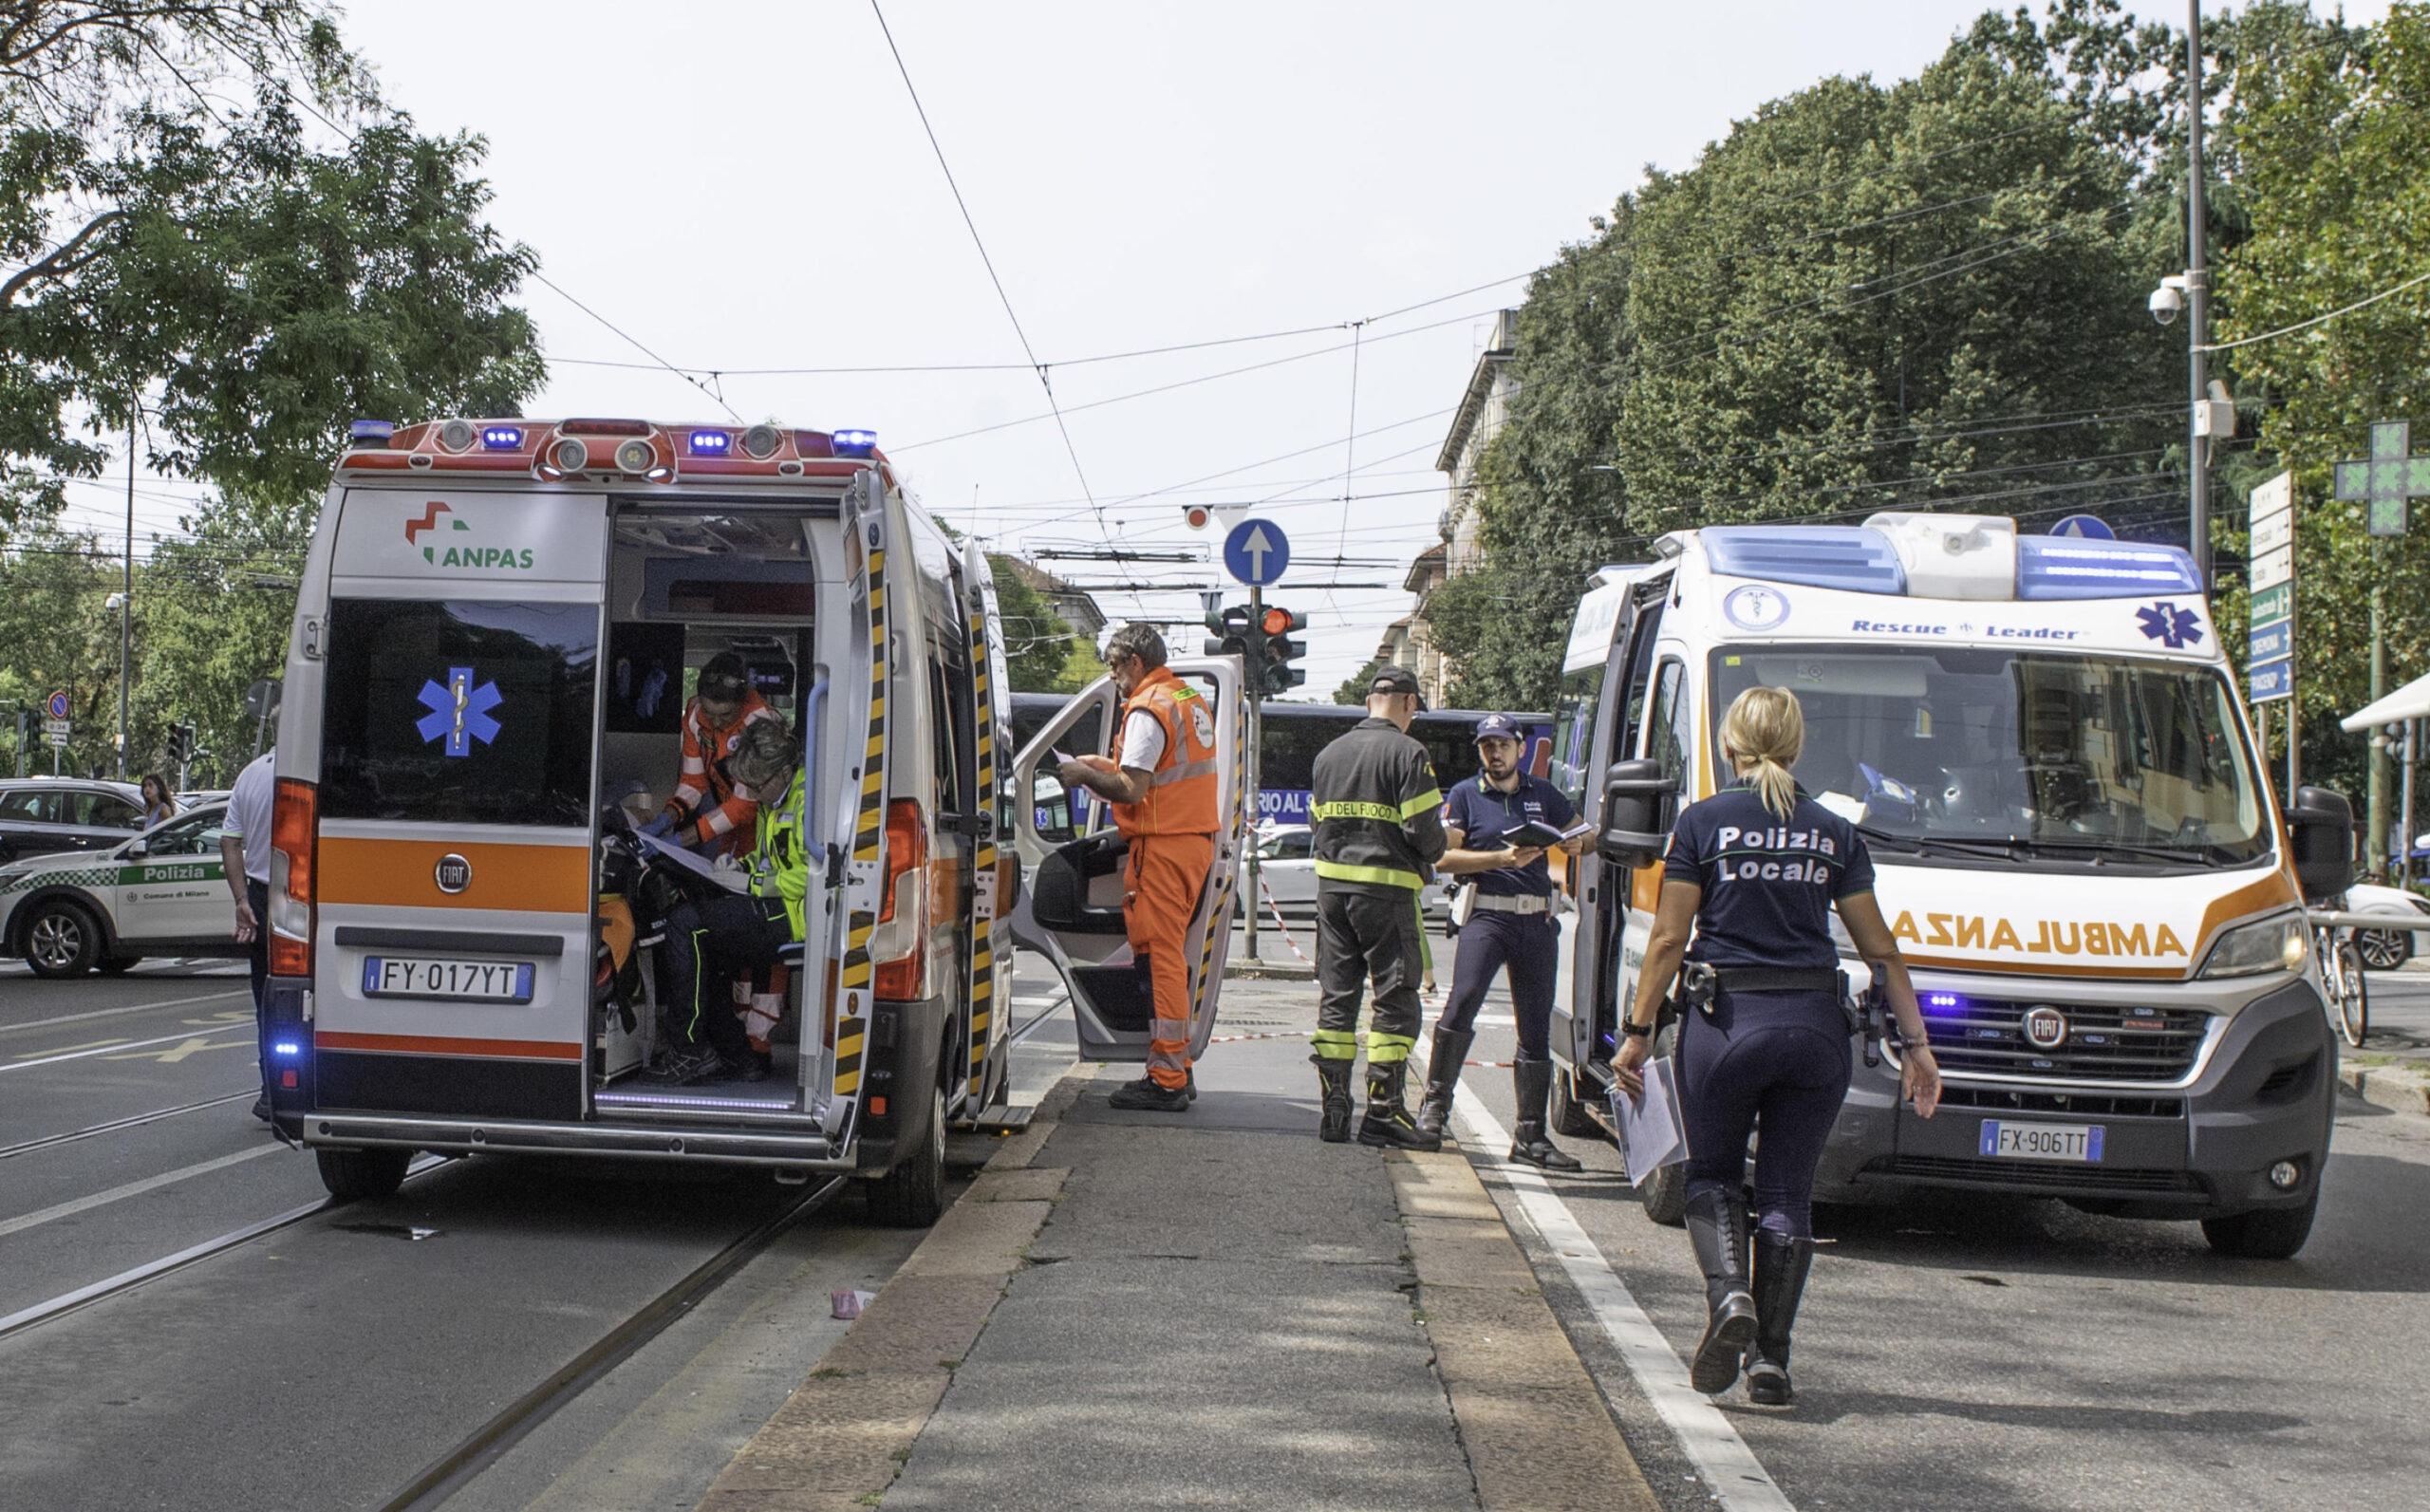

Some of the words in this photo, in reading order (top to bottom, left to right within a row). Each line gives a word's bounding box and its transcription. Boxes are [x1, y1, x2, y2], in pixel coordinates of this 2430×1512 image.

[442, 547, 534, 569] ANPAS
[1852, 620, 1948, 635] Rescue
[1986, 625, 2079, 640] Leader
[1282, 793, 1304, 813] AL
[1336, 803, 1357, 815] DEL
[1360, 803, 1392, 819] FUOCO
[1718, 826, 1836, 855] Polizia
[143, 866, 205, 881] Polizia
[442, 866, 465, 884] FIAT
[1717, 857, 1829, 885] Locale
[2034, 1018, 2058, 1037] FIAT
